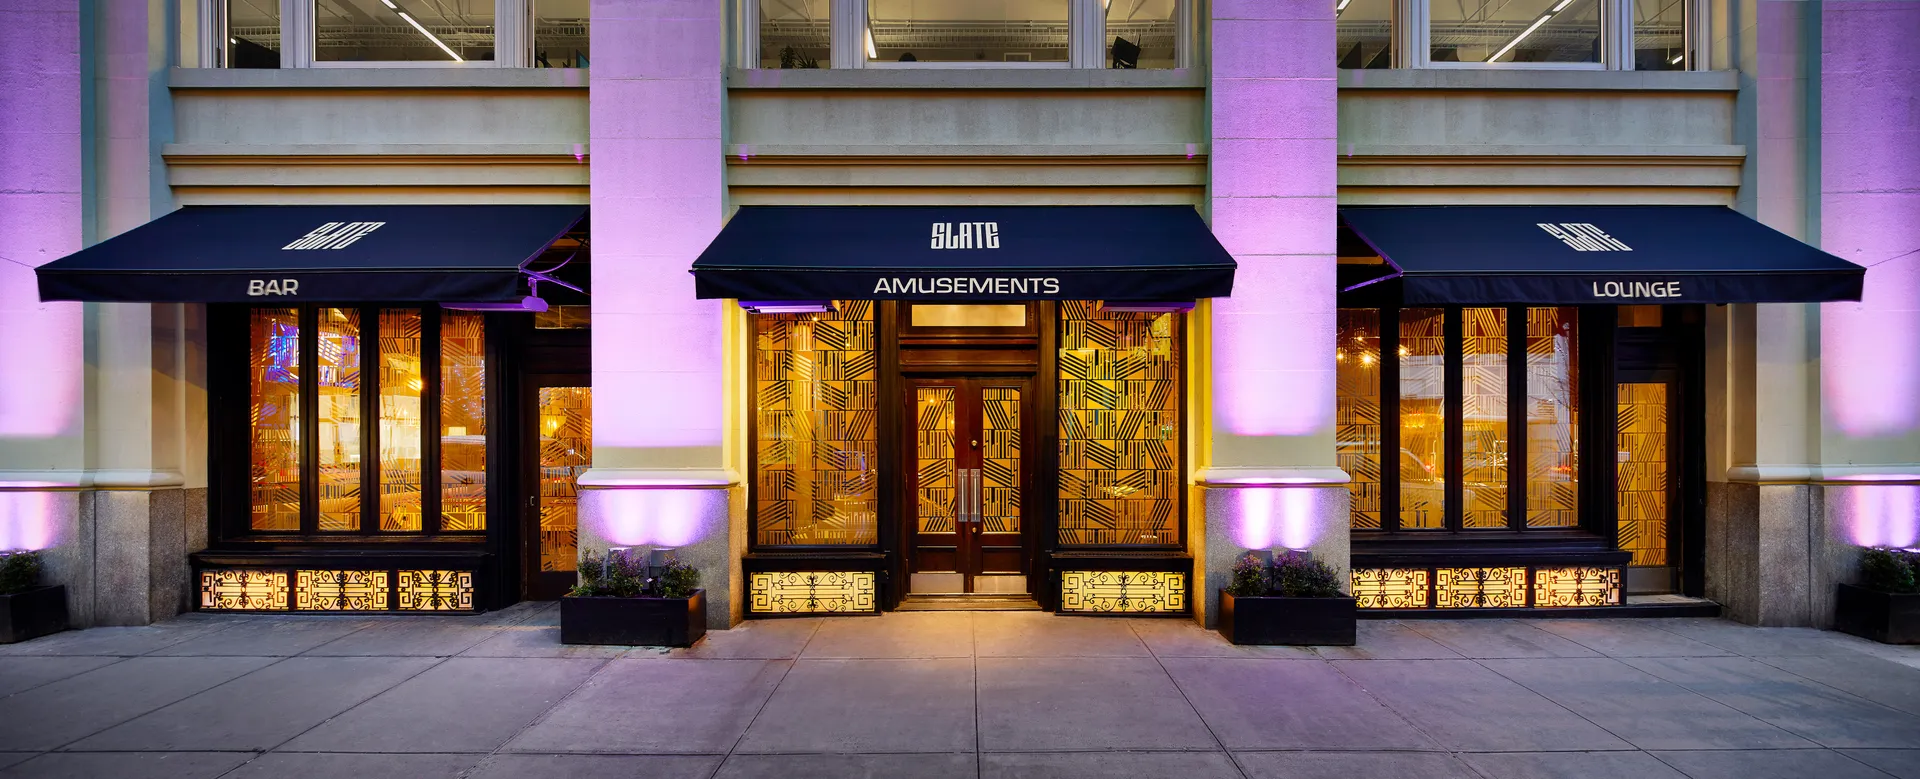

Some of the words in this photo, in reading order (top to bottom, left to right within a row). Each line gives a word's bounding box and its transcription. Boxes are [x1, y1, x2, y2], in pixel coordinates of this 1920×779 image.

[282, 222, 386, 250] SLATE
[931, 222, 999, 249] SLATE
[1537, 223, 1633, 251] SLATE
[247, 279, 299, 296] BAR
[873, 277, 1060, 294] AMUSEMENTS
[1593, 281, 1682, 298] LOUNGE
